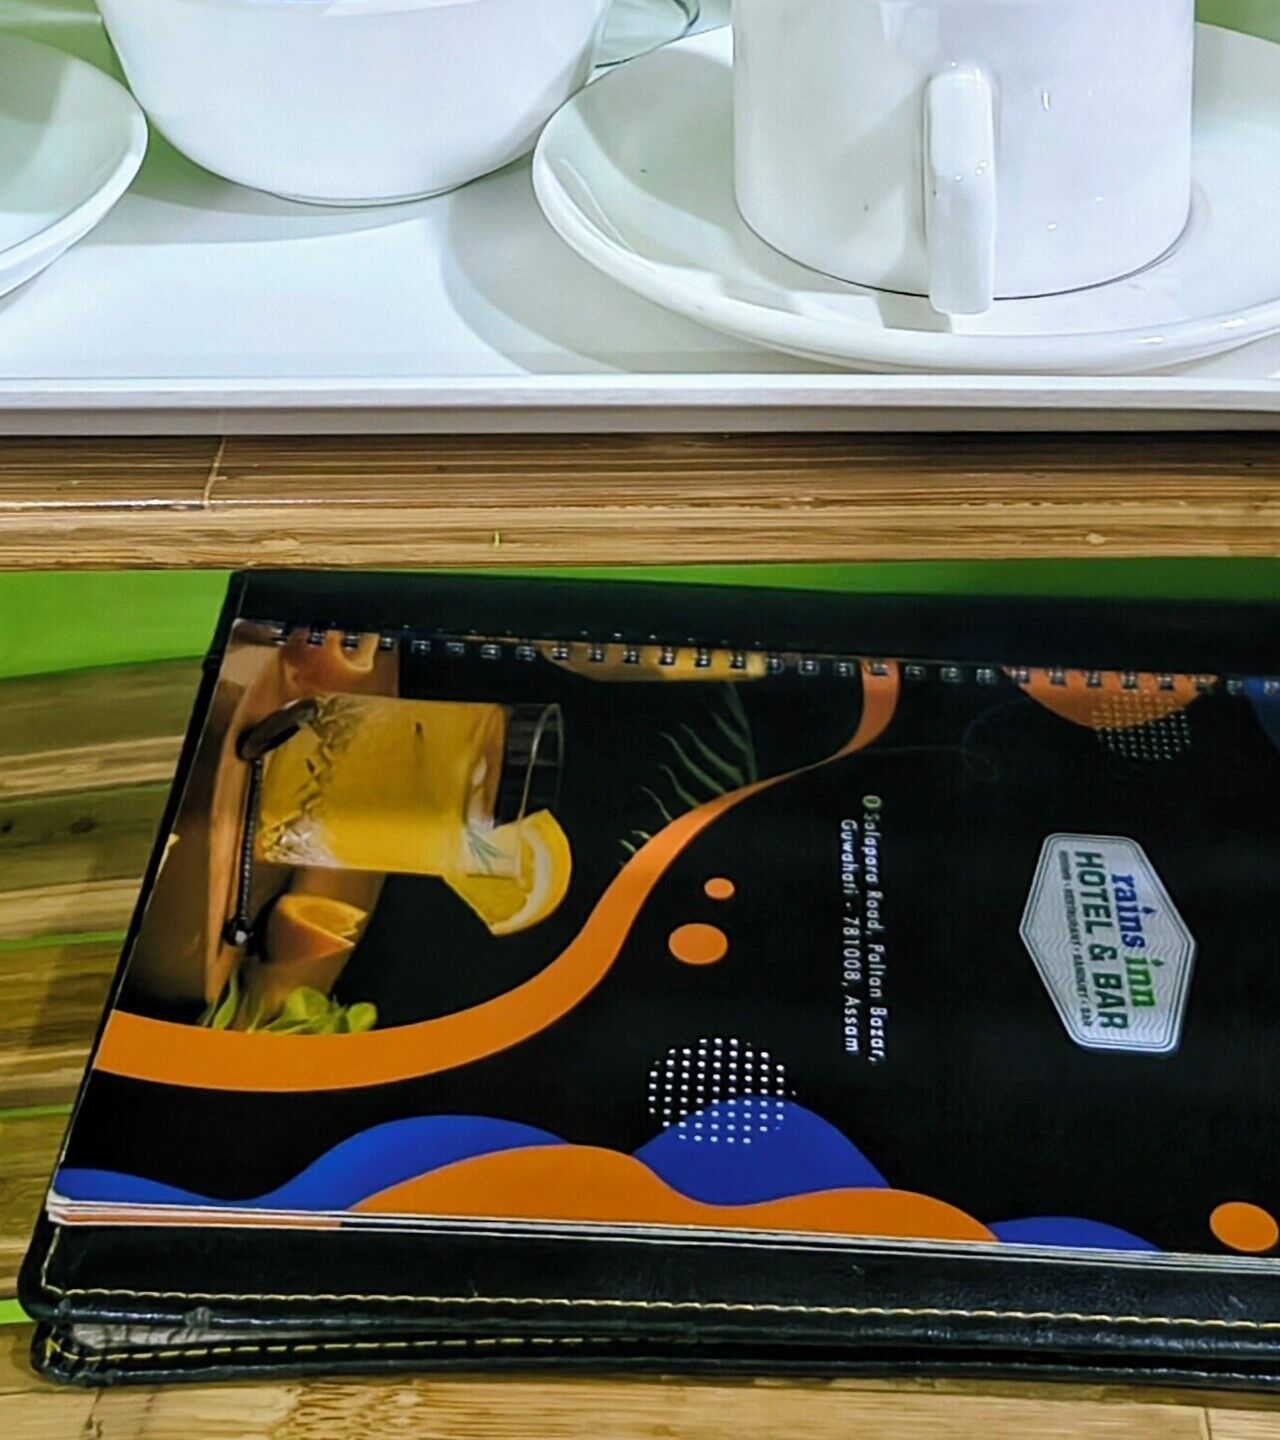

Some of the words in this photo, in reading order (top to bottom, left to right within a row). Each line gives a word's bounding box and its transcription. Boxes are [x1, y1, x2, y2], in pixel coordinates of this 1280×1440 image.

[840, 819, 860, 895] Guwahati
[865, 890, 885, 935] Road,
[1073, 850, 1113, 935] HOTEL
[1111, 873, 1155, 948] rains
[841, 917, 862, 987] 781008,
[868, 943, 887, 998] Paltan
[1087, 942, 1118, 962] &
[1091, 971, 1129, 1030] BAR
[1125, 955, 1165, 1008] inn
[844, 994, 862, 1052] Assam
[868, 1006, 888, 1062] Bazar,
